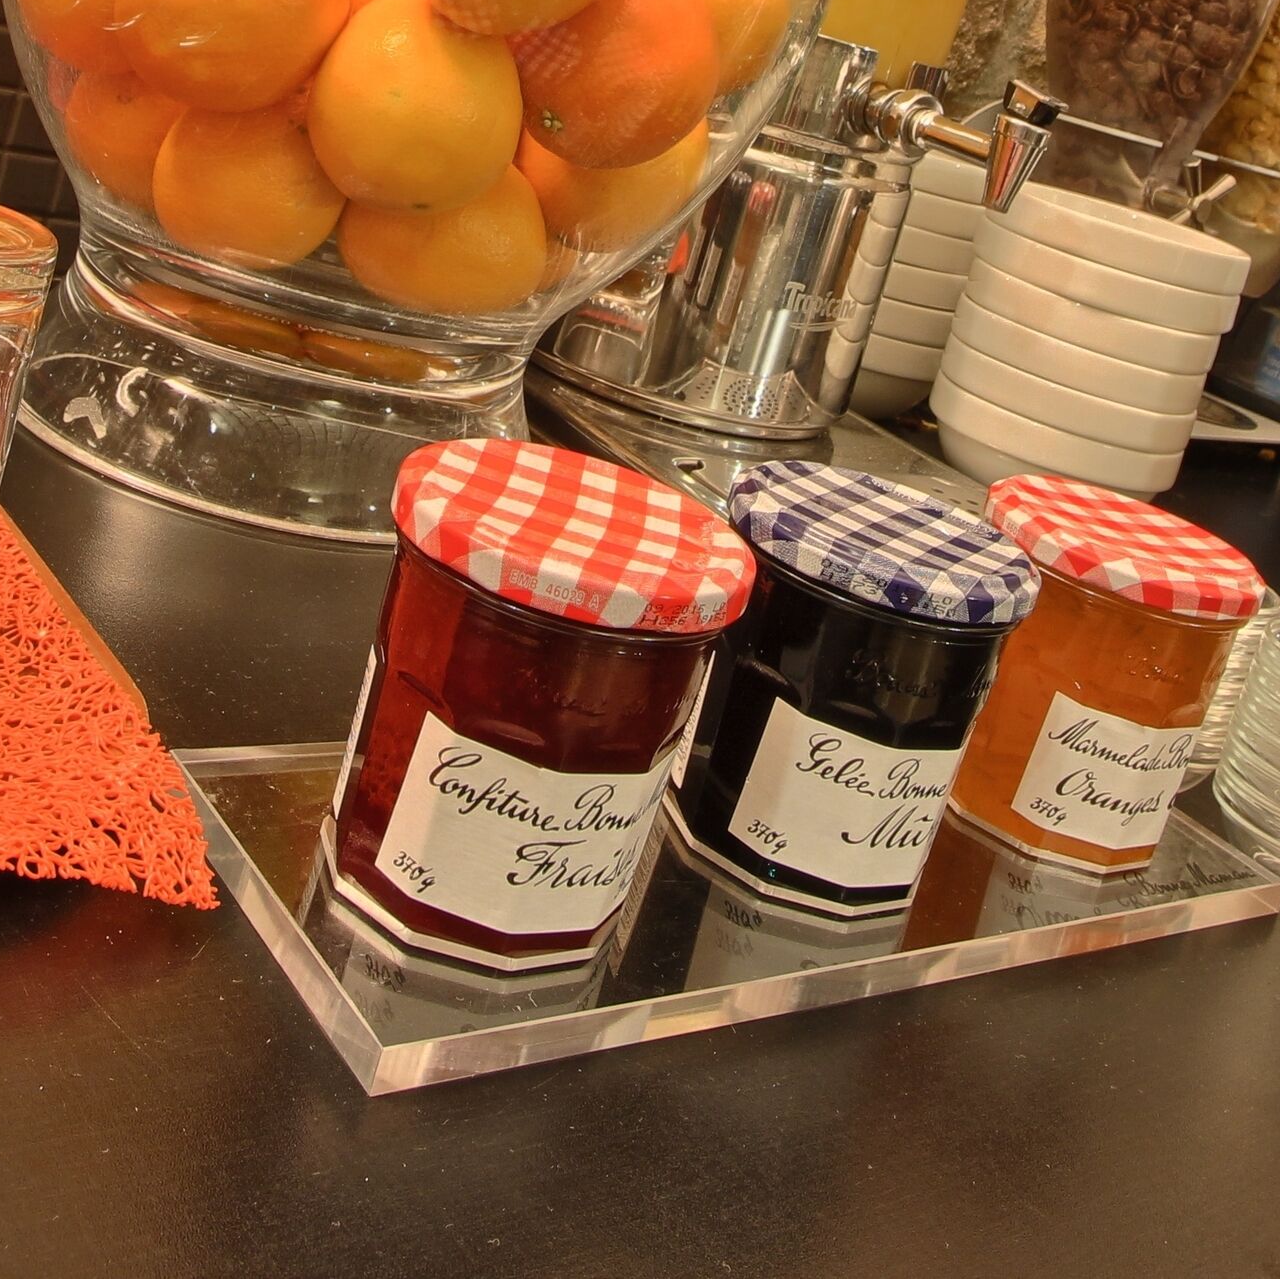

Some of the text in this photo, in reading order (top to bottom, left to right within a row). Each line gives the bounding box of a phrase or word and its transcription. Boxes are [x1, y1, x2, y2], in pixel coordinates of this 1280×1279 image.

[784, 281, 857, 319] Tropicana
[509, 569, 601, 609] EMB 46029 A
[795, 733, 948, 800] Gelée Bonne
[428, 746, 560, 832] Confiture
[1055, 768, 1165, 827] Oranges
[1030, 796, 1067, 827] 370g
[746, 819, 788, 855] 370g
[392, 850, 436, 893] 370g
